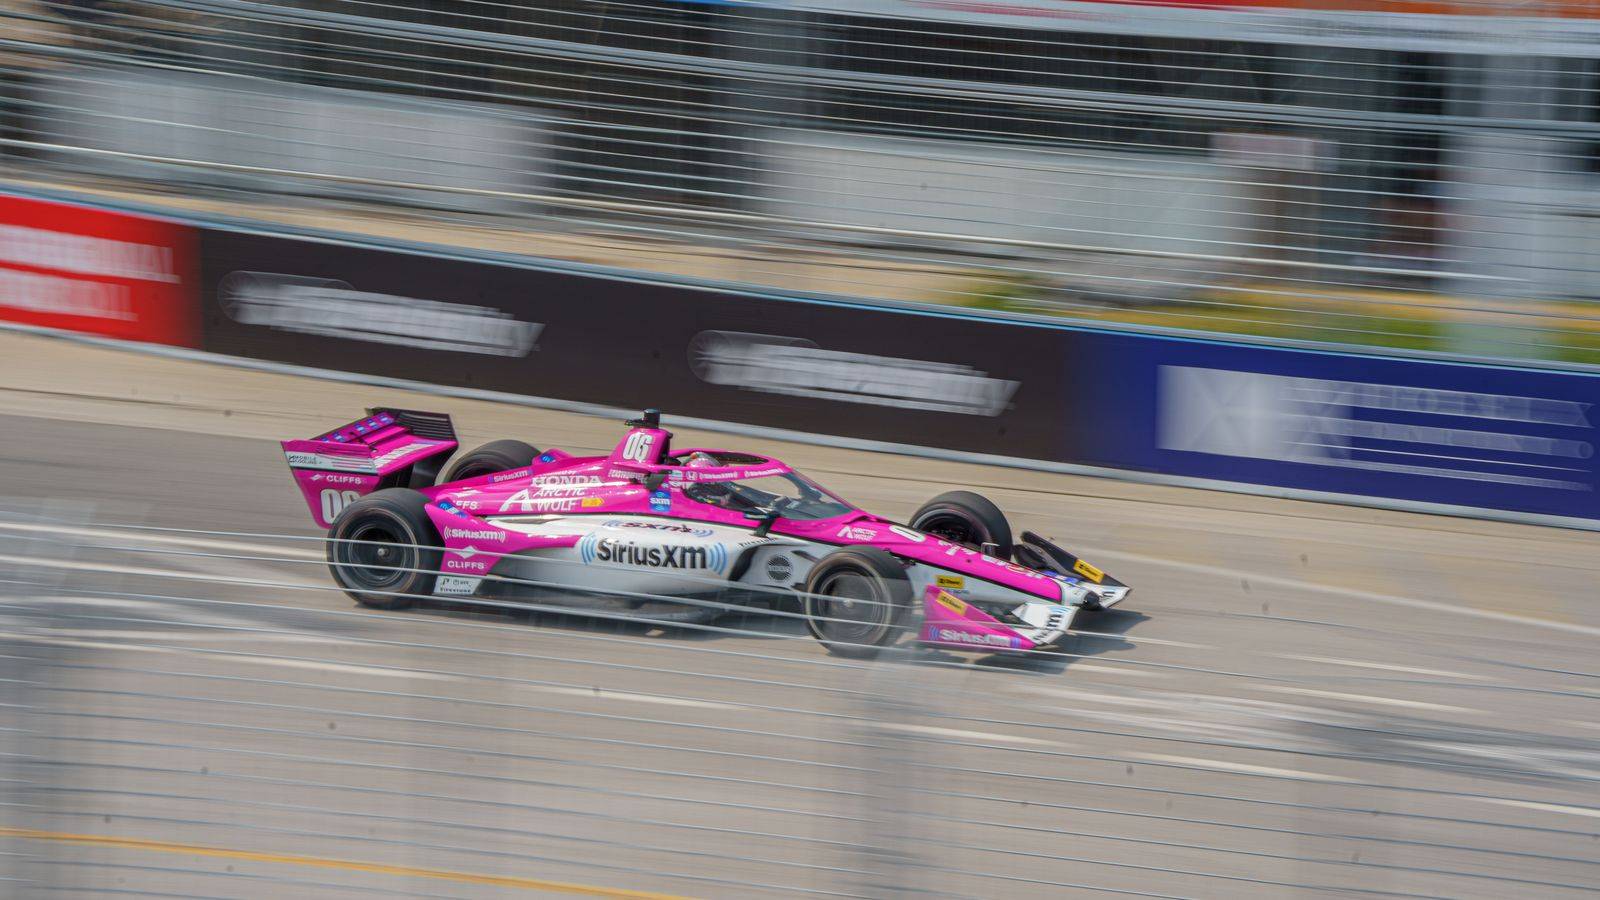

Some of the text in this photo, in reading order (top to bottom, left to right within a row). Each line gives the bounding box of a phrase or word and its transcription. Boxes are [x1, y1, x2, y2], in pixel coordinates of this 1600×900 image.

[623, 433, 652, 461] 06
[326, 475, 361, 484] CLIFFS
[532, 476, 602, 486] HONDA
[533, 487, 585, 497] ARCTIC
[537, 500, 576, 511] WOLF
[447, 561, 485, 569] CLIFFS
